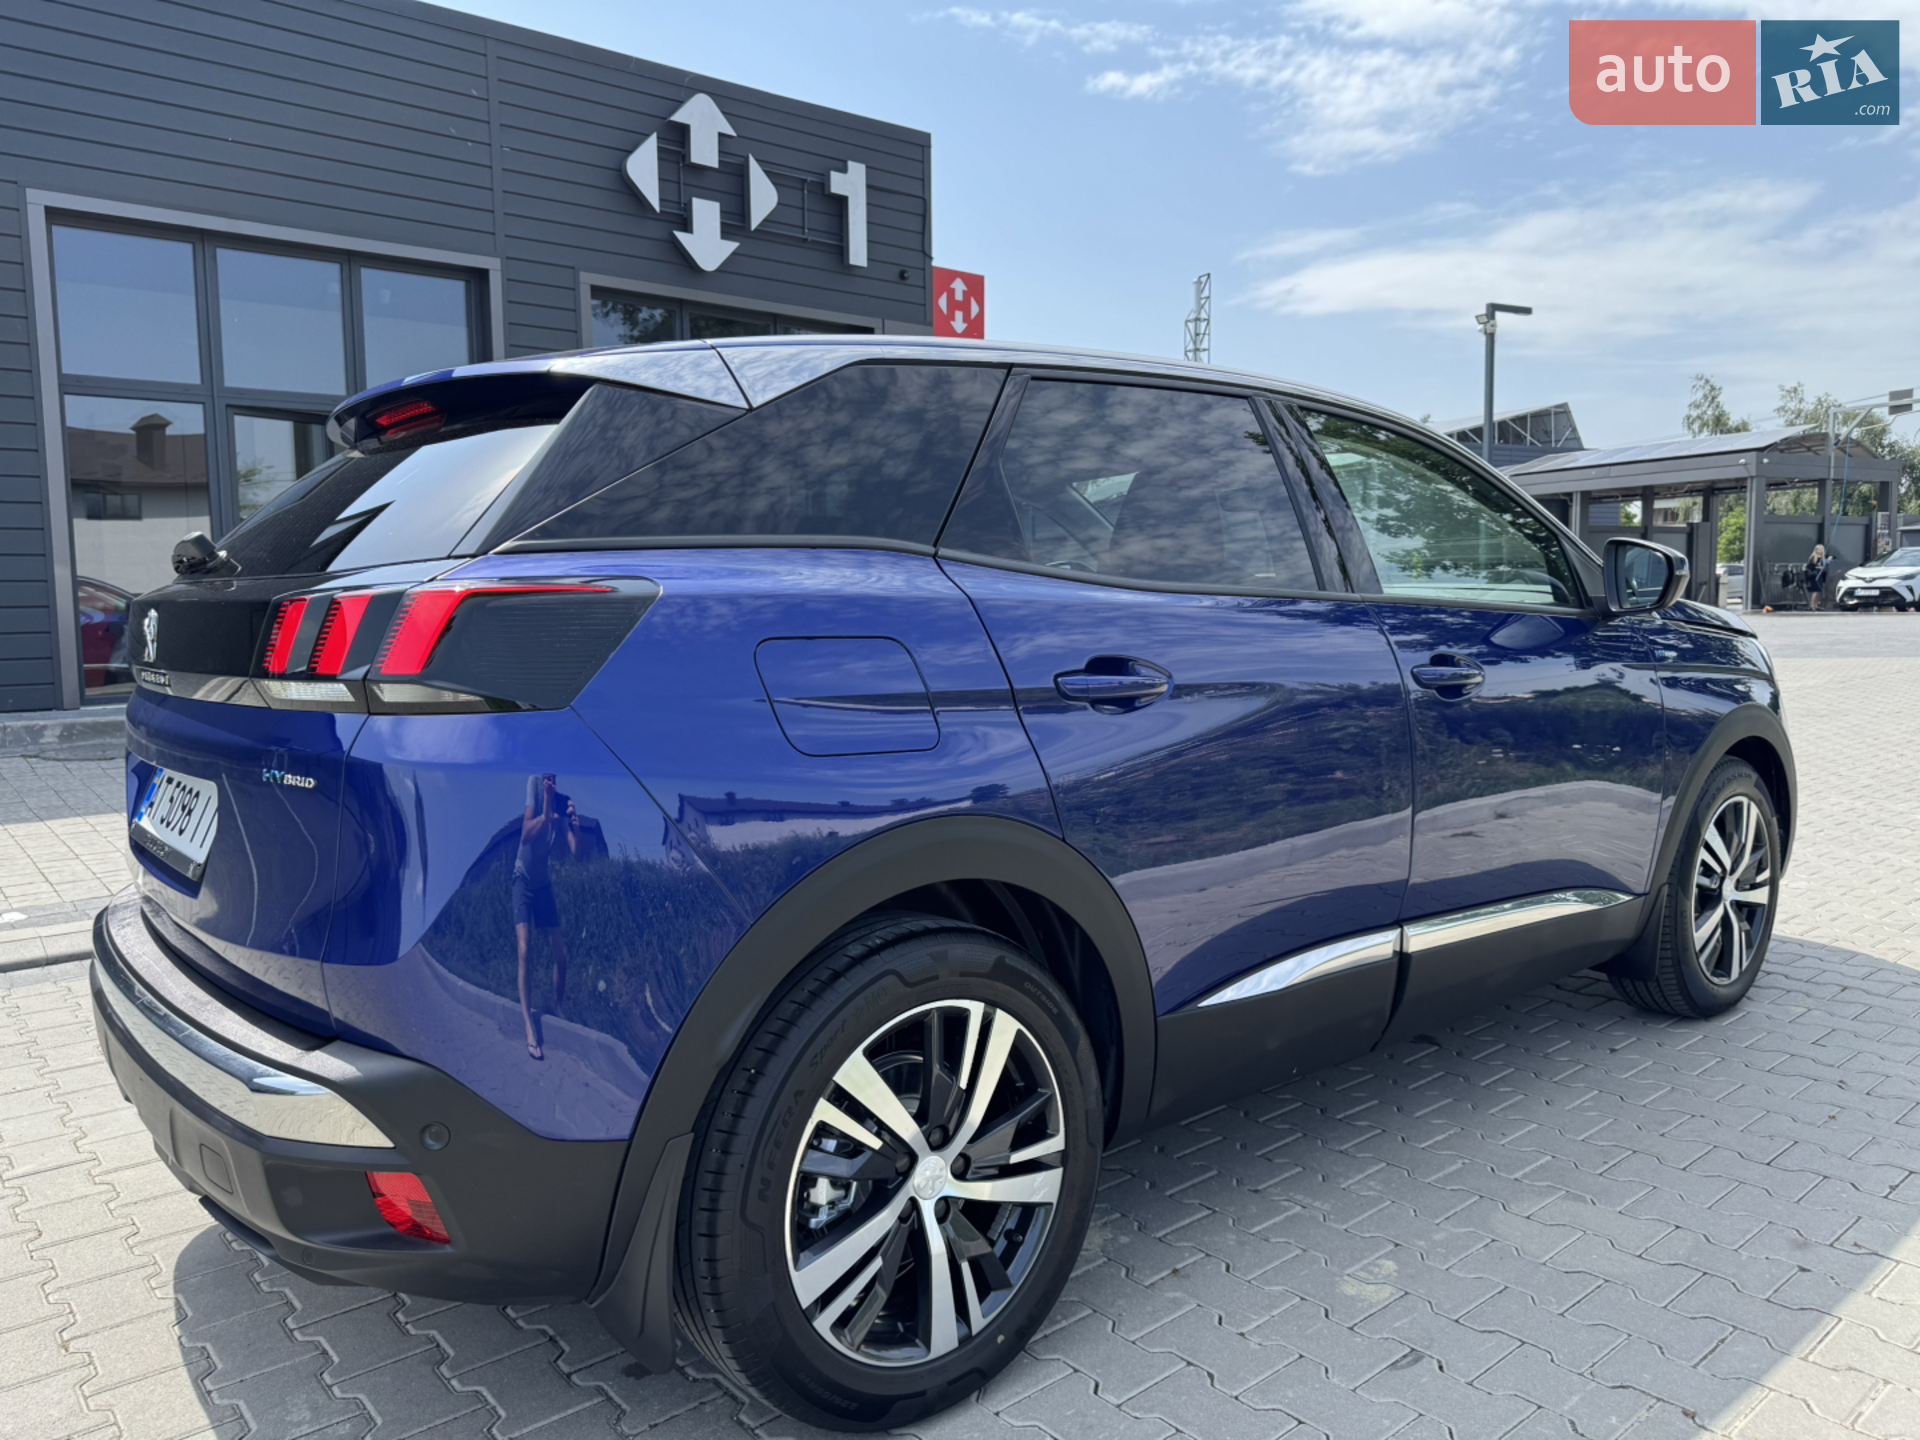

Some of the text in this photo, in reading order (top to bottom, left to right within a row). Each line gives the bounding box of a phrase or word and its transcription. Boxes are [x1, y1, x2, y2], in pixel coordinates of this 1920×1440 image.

[828, 160, 868, 268] 1
[262, 768, 316, 789] HYBRID
[808, 1017, 849, 1075] Sport
